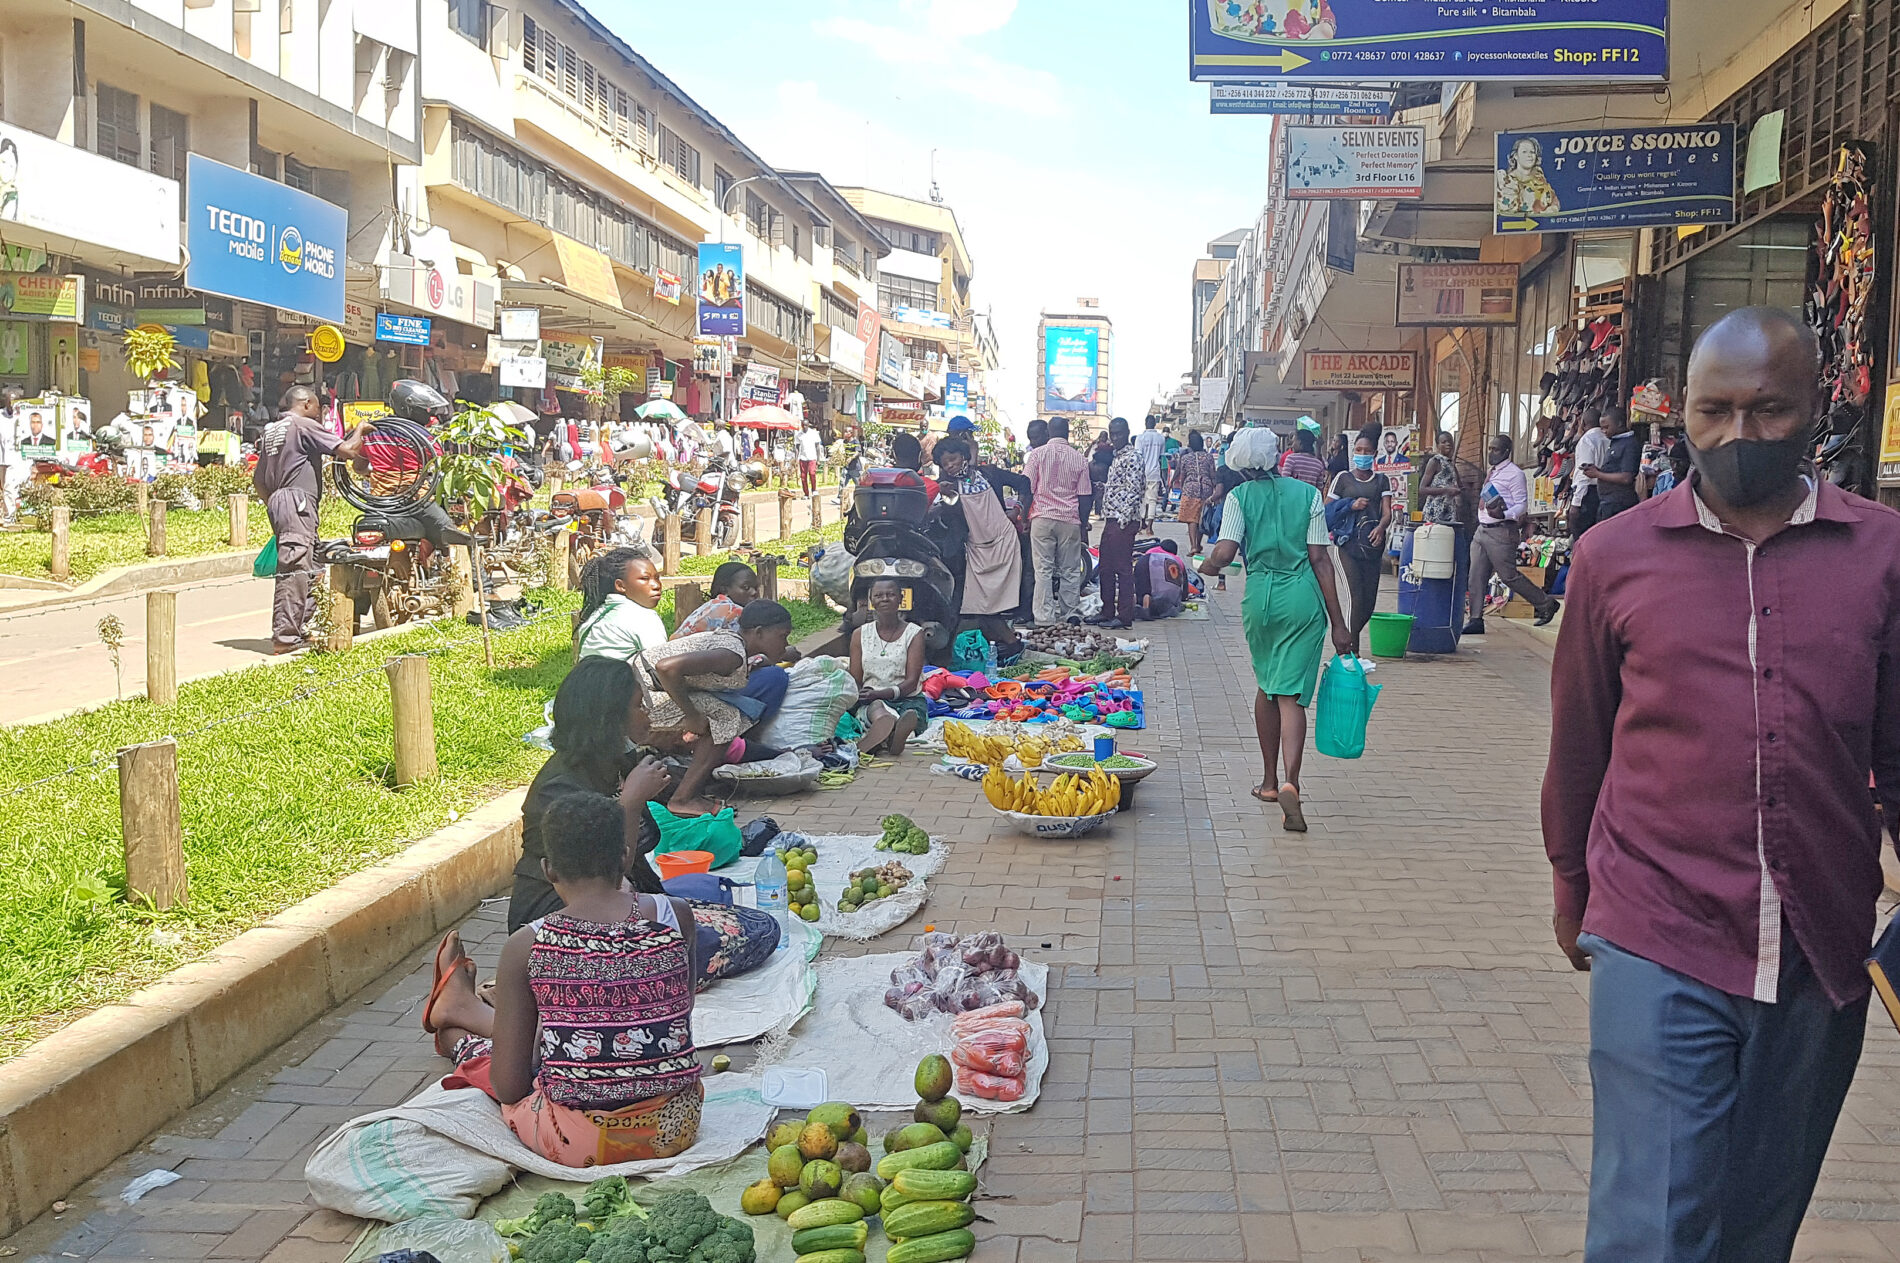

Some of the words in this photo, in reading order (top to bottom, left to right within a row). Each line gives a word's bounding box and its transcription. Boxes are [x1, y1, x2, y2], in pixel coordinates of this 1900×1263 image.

[1437, 6, 1459, 17] Pure
[1461, 7, 1477, 17] silk
[1492, 7, 1536, 17] Bitambala
[1332, 51, 1352, 60] 0772
[1355, 51, 1386, 60] 428637
[1391, 51, 1411, 60] 0701
[1414, 51, 1445, 60] 428637
[1467, 51, 1549, 61] joycessonkotextiles
[1553, 49, 1597, 65] Shop:
[1602, 48, 1640, 62] FF12
[1266, 90, 1276, 98] 232
[1308, 91, 1318, 99] 44
[1342, 131, 1375, 147] SELYN
[1377, 131, 1419, 147] EVENTS
[1554, 134, 1625, 155] JOYCE
[1630, 130, 1721, 151] SSONKO
[1355, 173, 1371, 181] 3rd
[1373, 173, 1396, 181] Floor
[1674, 210, 1699, 218] Shop:
[1700, 208, 1722, 216] FF12
[206, 204, 266, 244] TECNO
[305, 240, 335, 264] PHONE
[304, 256, 335, 279] WORLD
[1422, 278, 1494, 288] ENTERPRISE
[447, 282, 464, 309] LG
[397, 317, 423, 328] FINE
[1310, 354, 1343, 371] THE
[1347, 355, 1411, 371] ARCADE
[753, 389, 778, 400] Stanbic
[883, 409, 926, 421] Bata
